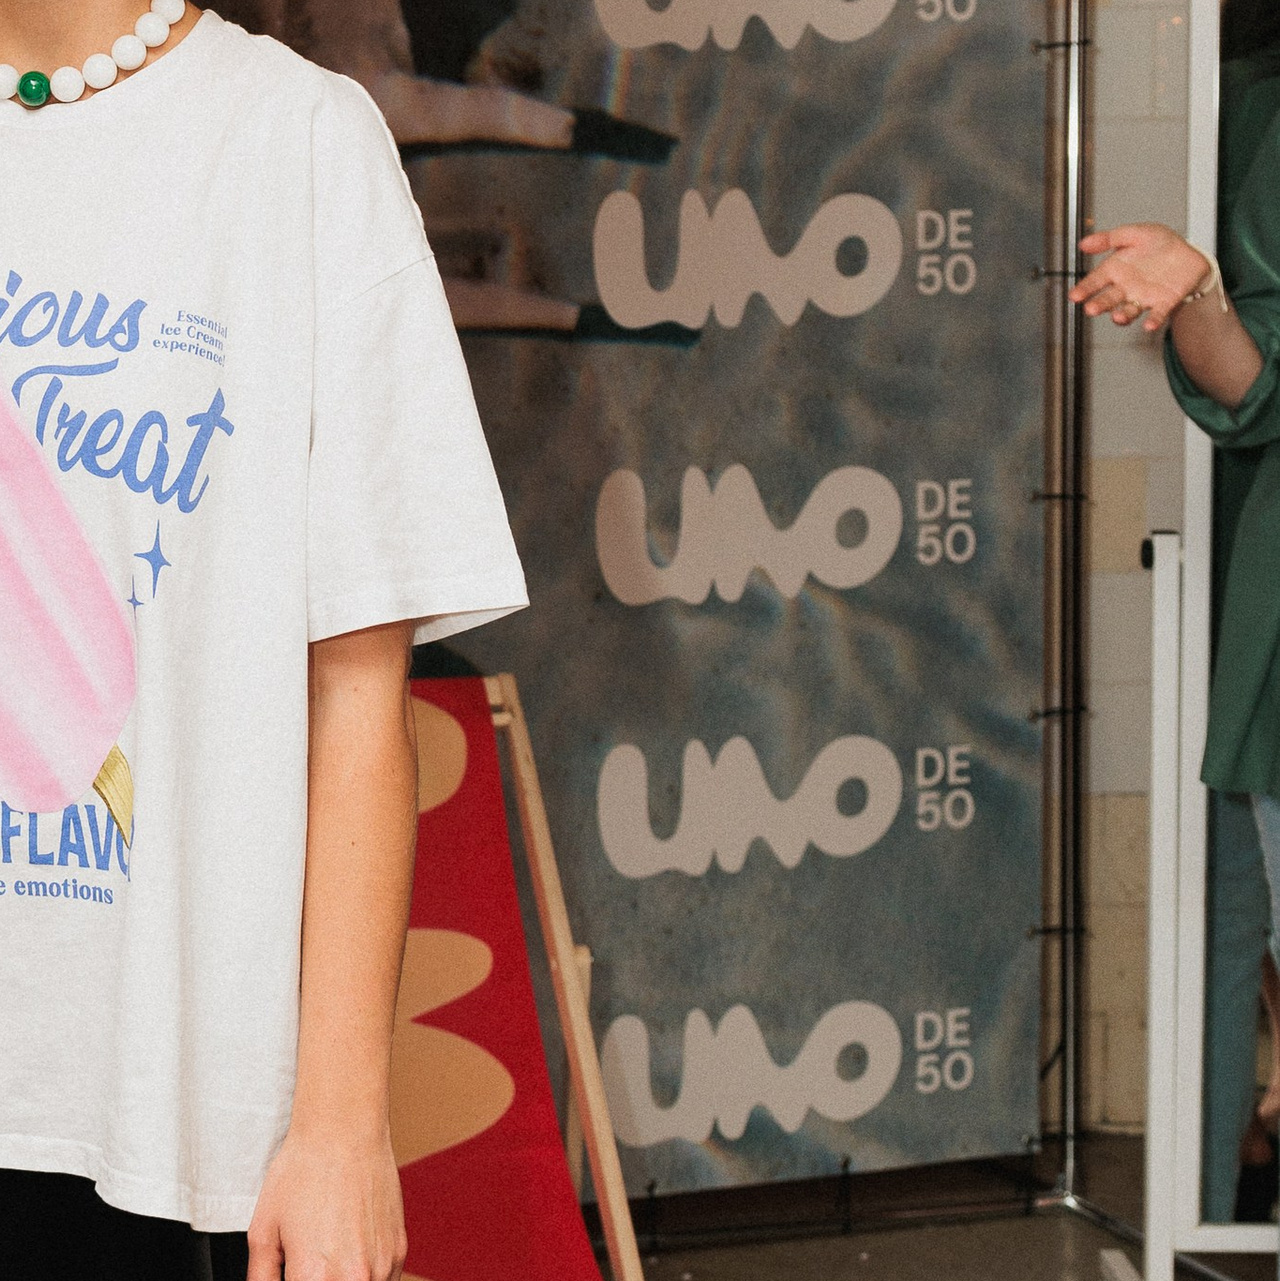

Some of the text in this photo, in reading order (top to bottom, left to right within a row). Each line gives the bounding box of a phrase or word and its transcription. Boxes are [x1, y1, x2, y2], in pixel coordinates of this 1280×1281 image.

[916, 210, 974, 250] DE
[915, 255, 978, 295] 50
[160, 323, 224, 351] Ice Cream
[177, 310, 228, 339] Essential
[152, 339, 226, 368] experience!
[11, 357, 236, 514] Treat
[916, 479, 973, 520] DE
[916, 525, 977, 565] 50
[915, 747, 971, 787] DE
[915, 792, 976, 832] 50
[13, 879, 115, 906] emotions
[915, 1009, 971, 1048] DE
[915, 1053, 974, 1094] 50
